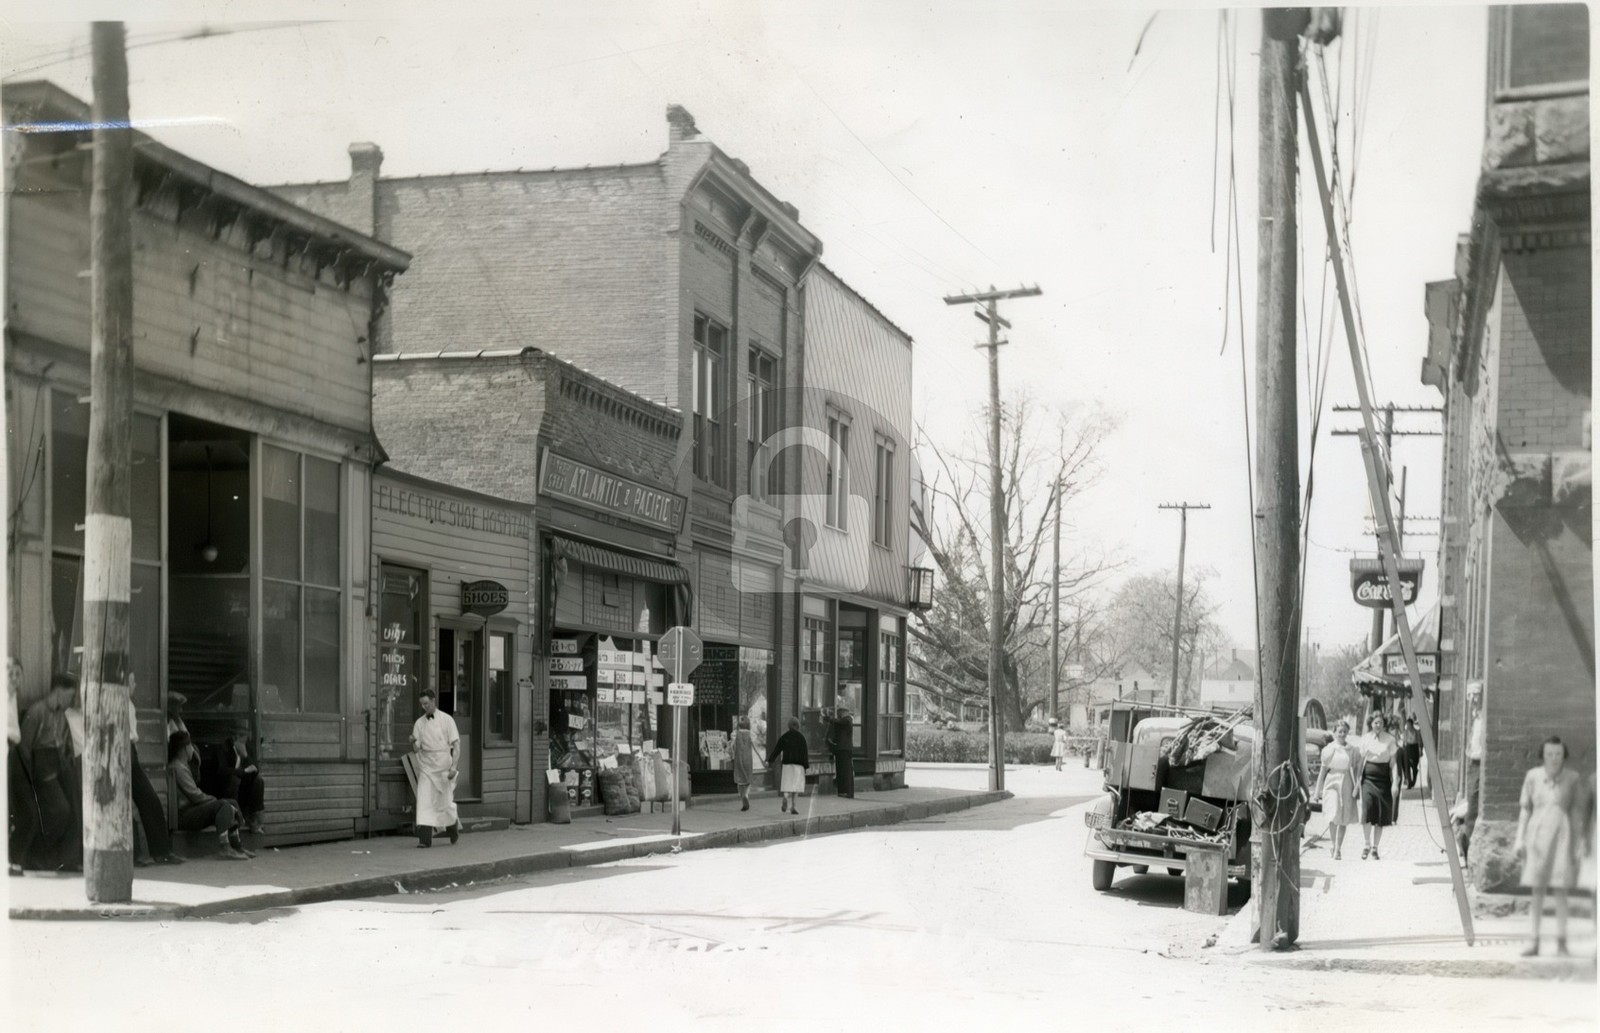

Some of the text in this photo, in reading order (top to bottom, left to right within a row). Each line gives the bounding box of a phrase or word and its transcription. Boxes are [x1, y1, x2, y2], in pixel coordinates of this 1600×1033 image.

[378, 485, 530, 539] ELECTRIC SHOE HOSPITAL
[569, 467, 622, 507] ATLANTIC
[623, 489, 630, 505] &
[632, 488, 672, 521] PACIFIC
[463, 592, 507, 604] SHOES
